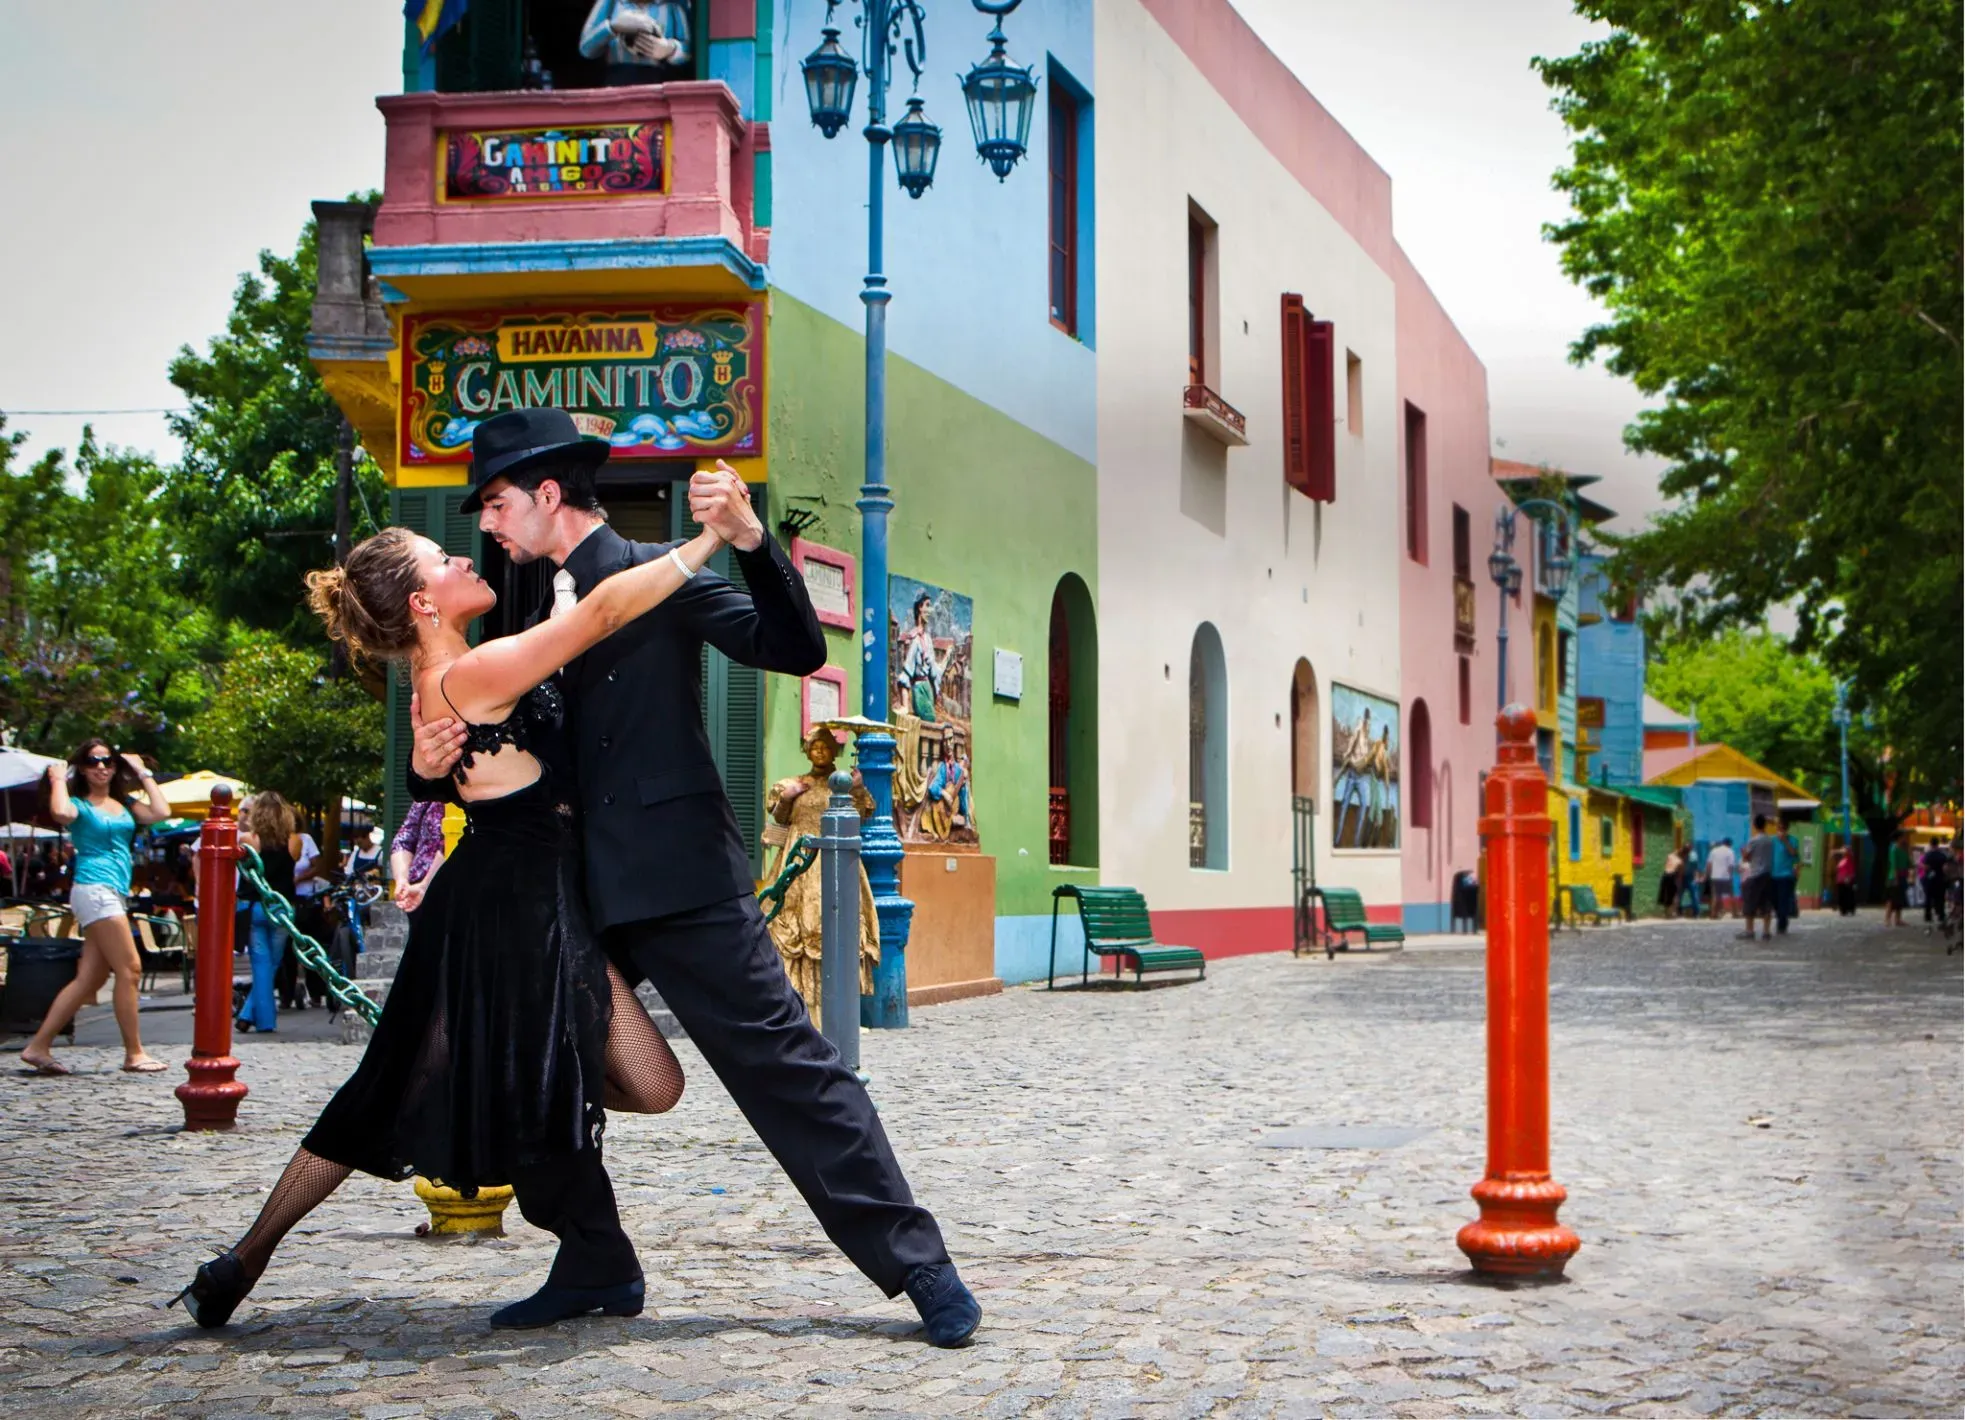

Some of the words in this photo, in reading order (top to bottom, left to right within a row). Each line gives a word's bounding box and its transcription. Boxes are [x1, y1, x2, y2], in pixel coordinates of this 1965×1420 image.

[511, 164, 602, 183] AMIGO
[512, 328, 644, 355] HAVANNA
[432, 376, 442, 391] H
[717, 366, 728, 381] H
[456, 355, 704, 413] CAMINITO
[586, 415, 614, 437] 1948
